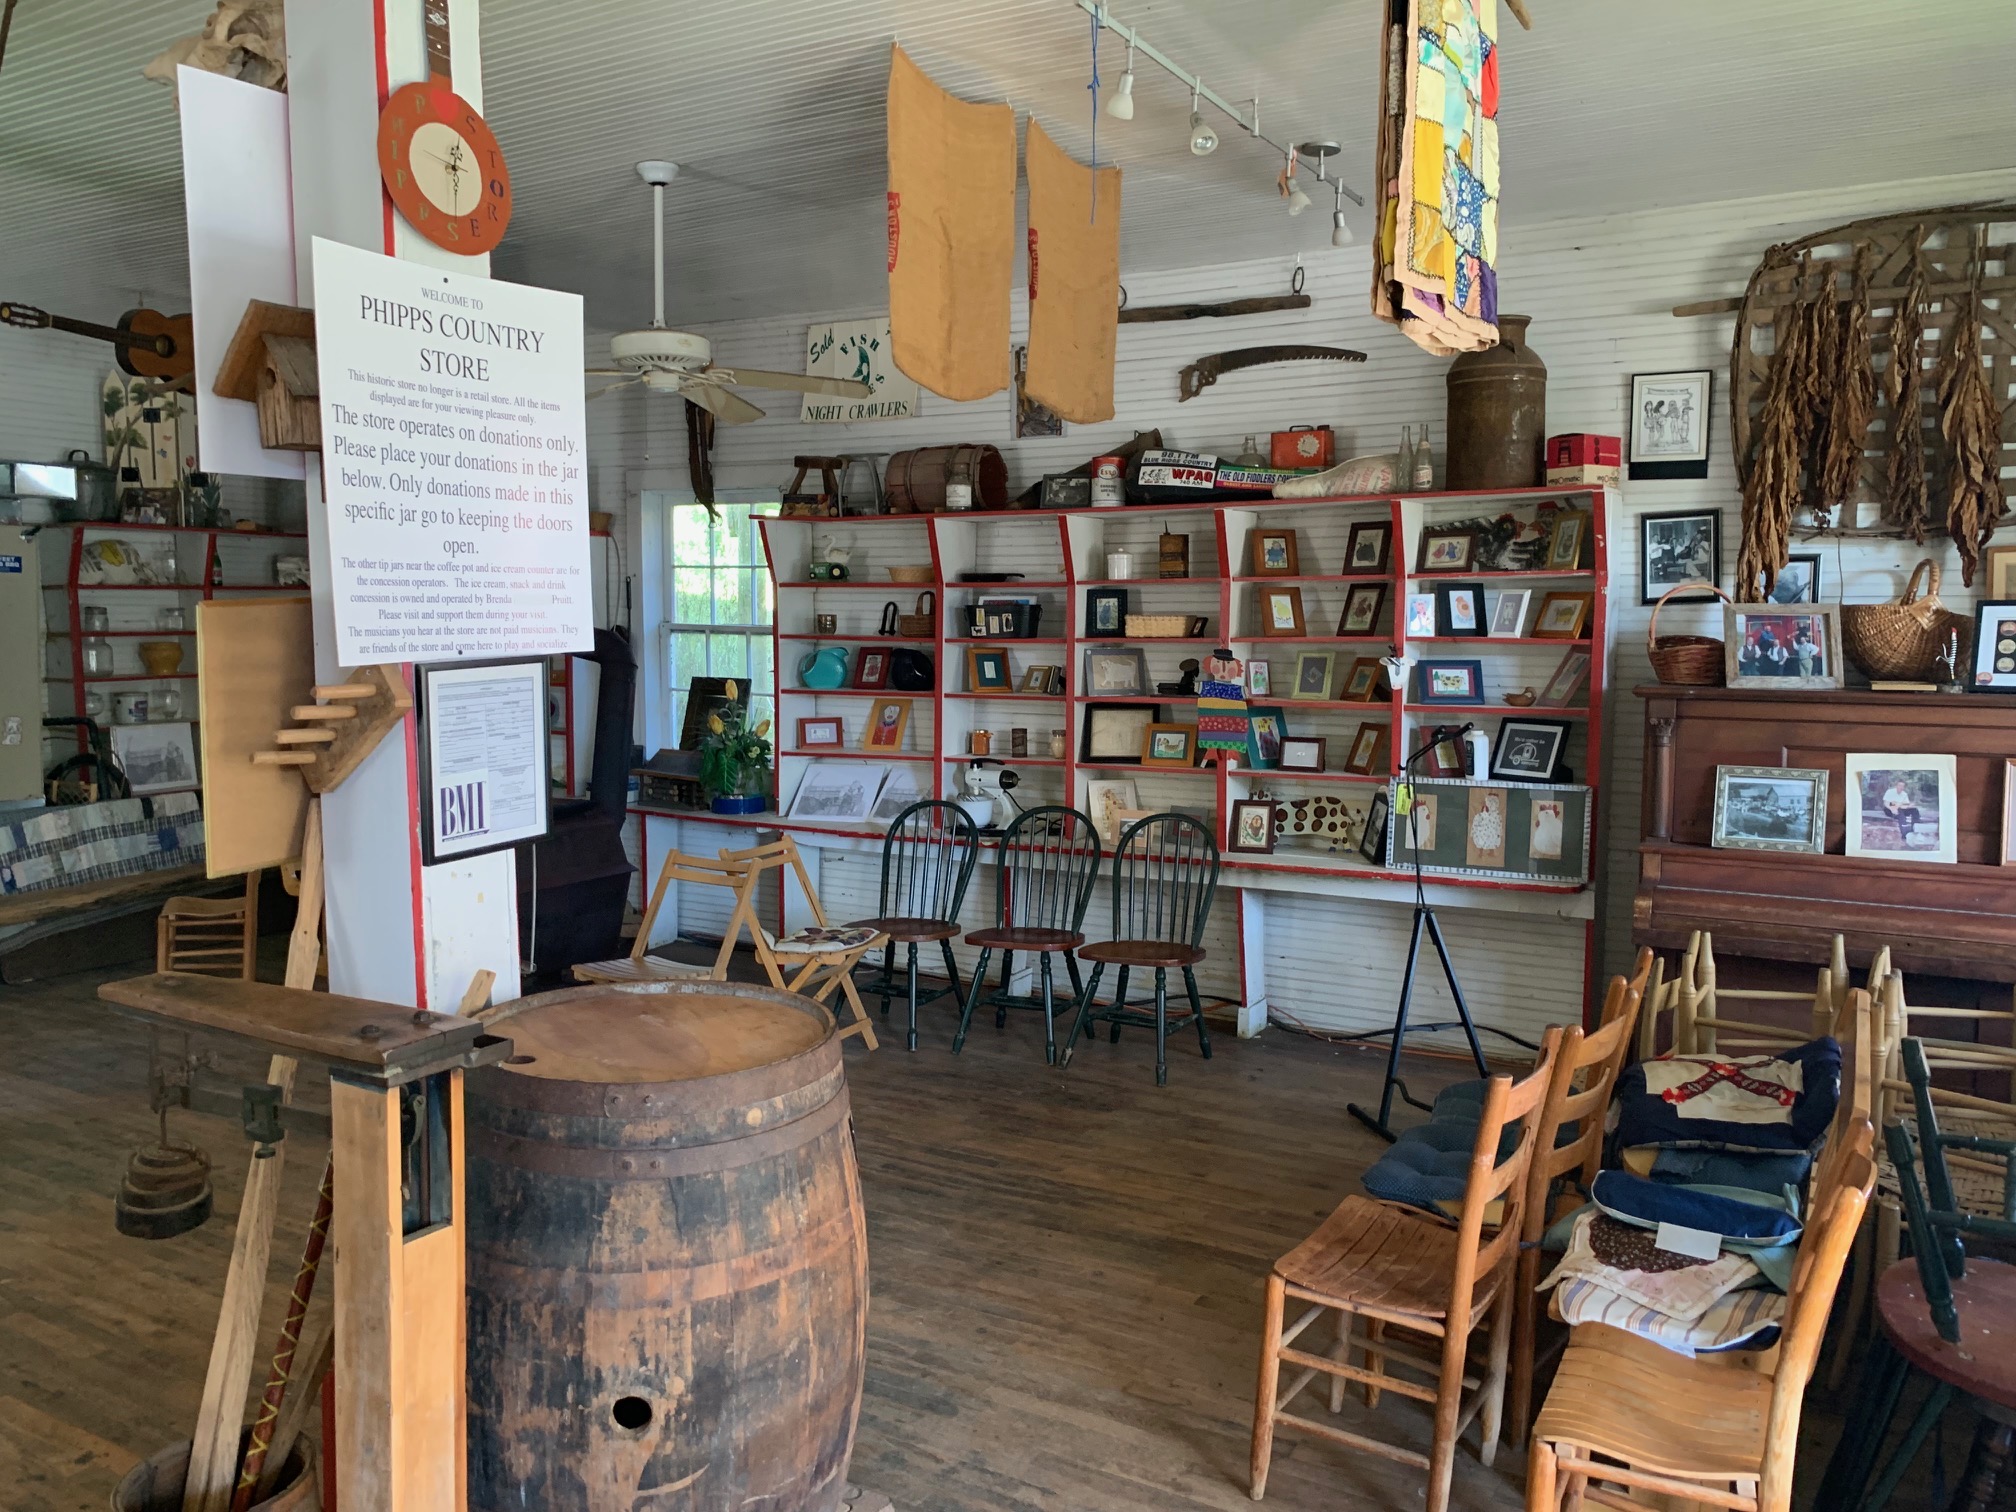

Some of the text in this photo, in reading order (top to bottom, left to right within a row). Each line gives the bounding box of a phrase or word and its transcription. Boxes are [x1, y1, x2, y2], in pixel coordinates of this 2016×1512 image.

[421, 287, 484, 311] WELCOME TO
[360, 294, 545, 353] PHIPPS COUNTRY
[810, 328, 834, 364] Sold
[840, 334, 880, 355] FISH
[420, 348, 490, 381] STORE
[348, 368, 560, 411] This historic store no longer is a retail store. All the items
[370, 390, 536, 426] displayed are for your viewing pleasure only.
[805, 401, 908, 420] NIGHT CRAWLERS
[331, 403, 578, 456] The store operates on donations only.
[333, 435, 579, 482] Please place your donations in the jar
[1183, 459, 1213, 467] COUNTRY
[341, 467, 573, 505] below. Only donations made in this
[1172, 468, 1213, 483] WPAQ
[1220, 471, 1232, 480] THE
[1233, 472, 1246, 482] OLD
[1246, 473, 1276, 484] FIDDLERS
[345, 501, 573, 533] specific jar go to keeping the doors
[443, 540, 479, 558] open.
[341, 557, 356, 568] The
[358, 558, 377, 569] other
[379, 559, 389, 572] tip
[391, 560, 404, 572] jars
[406, 562, 422, 570] near
[424, 561, 435, 570] the
[437, 561, 459, 571] coffee
[462, 564, 474, 574] pot
[476, 563, 488, 573] and
[491, 563, 501, 573] ice
[503, 566, 525, 574] cream
[527, 566, 554, 575] counter
[569, 566, 580, 575] for
[357, 575, 566, 590] the concession operators. The ice cream, snack and drink
[350, 592, 574, 606] concession is owned and operated by Brenda Pruitt.
[378, 609, 547, 622] Please visit and support them during your visit.
[348, 624, 579, 639] The musicians you hear at the store are not paid musicians. They
[359, 639, 569, 654] are friends of the store and come here to play and socialize.
[440, 781, 486, 837] BMI
